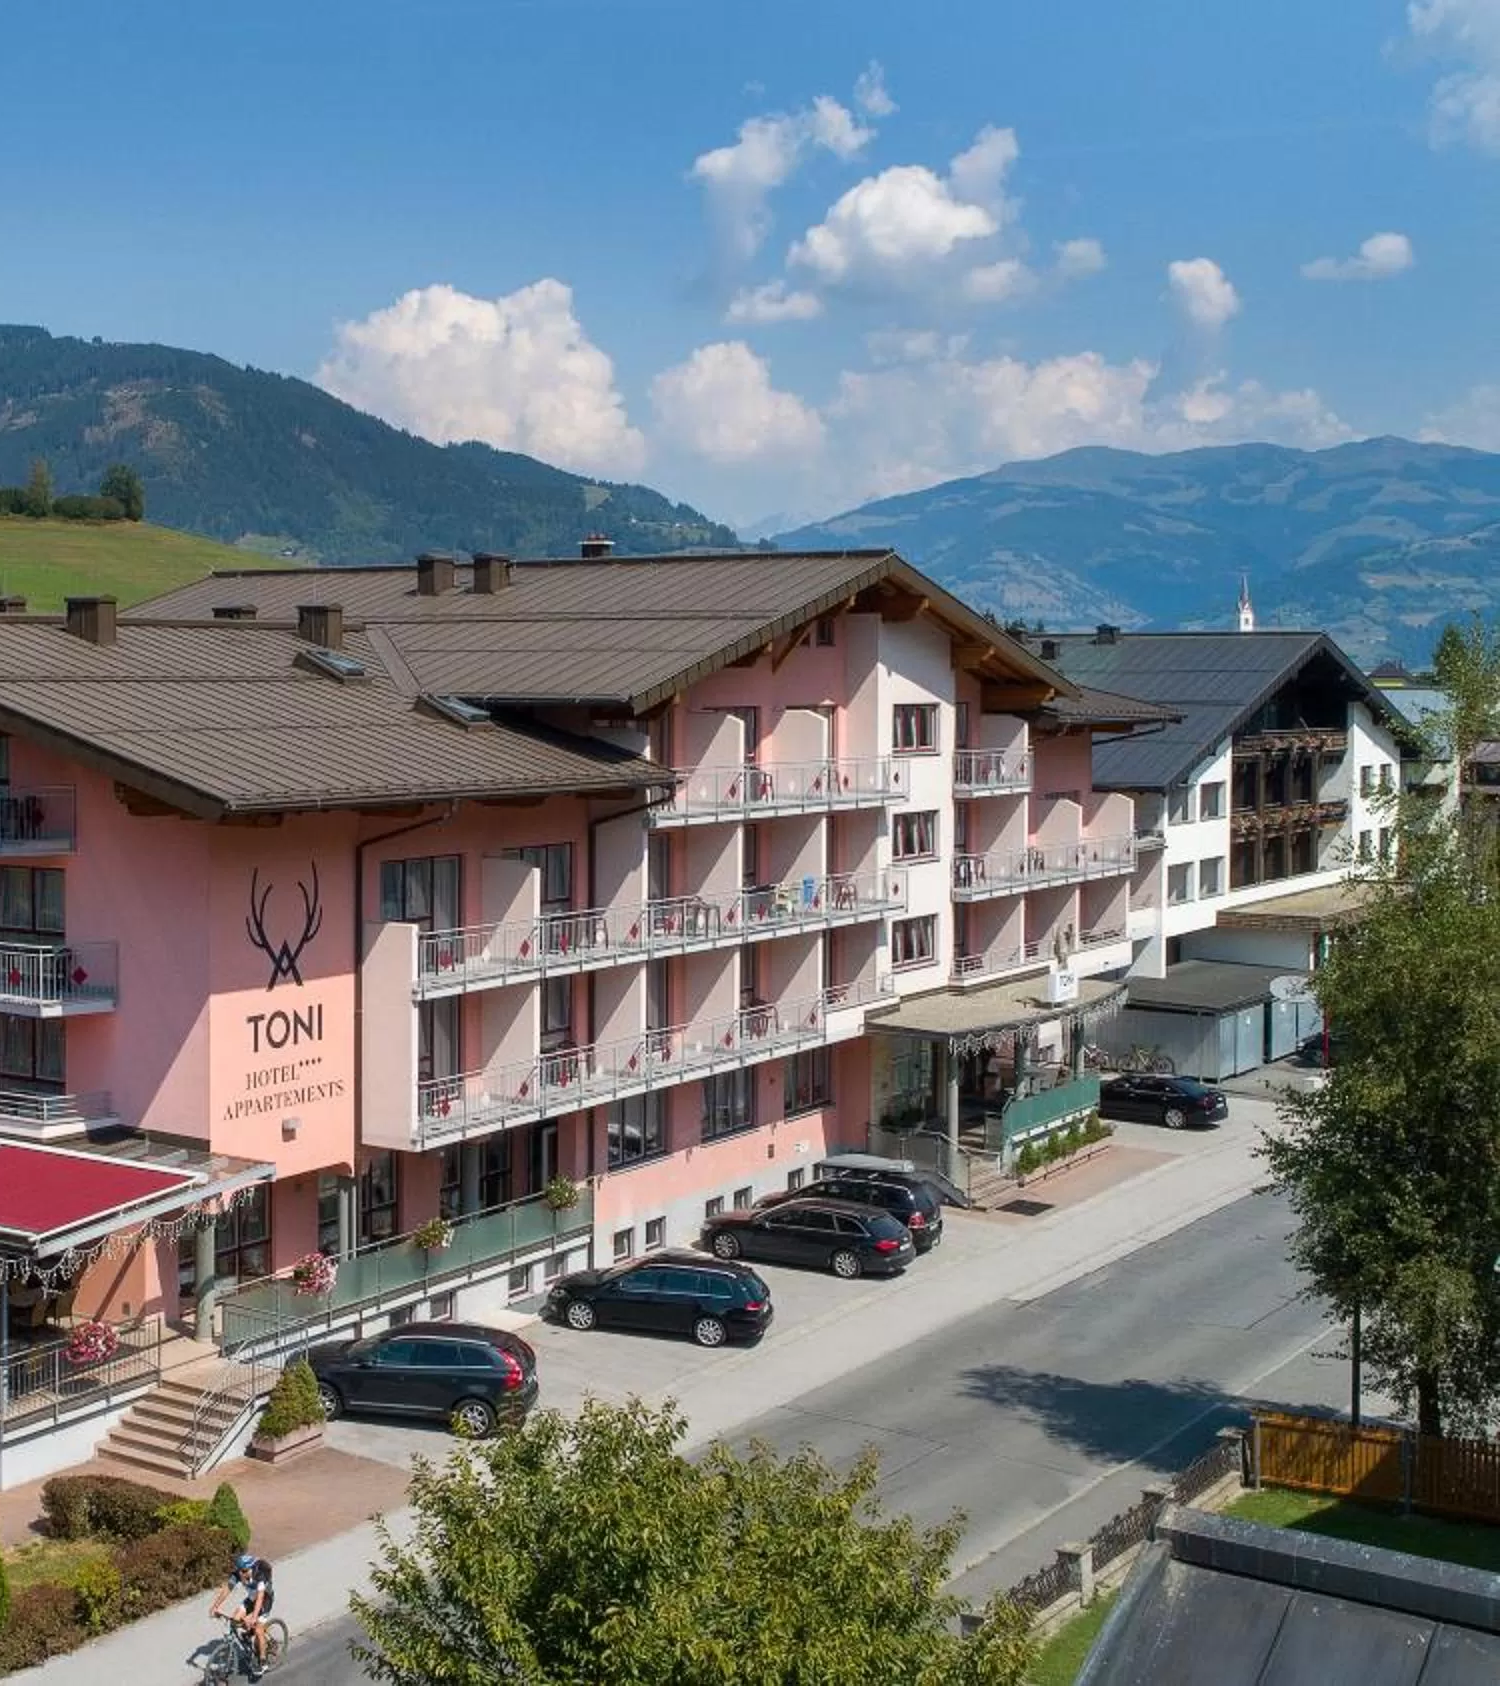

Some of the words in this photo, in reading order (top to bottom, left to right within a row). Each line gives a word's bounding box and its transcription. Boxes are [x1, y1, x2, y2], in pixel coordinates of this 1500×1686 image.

[246, 1003, 323, 1053] TONI
[245, 1063, 299, 1090] HOTEL
[223, 1079, 346, 1121] APPARTEMENTS
